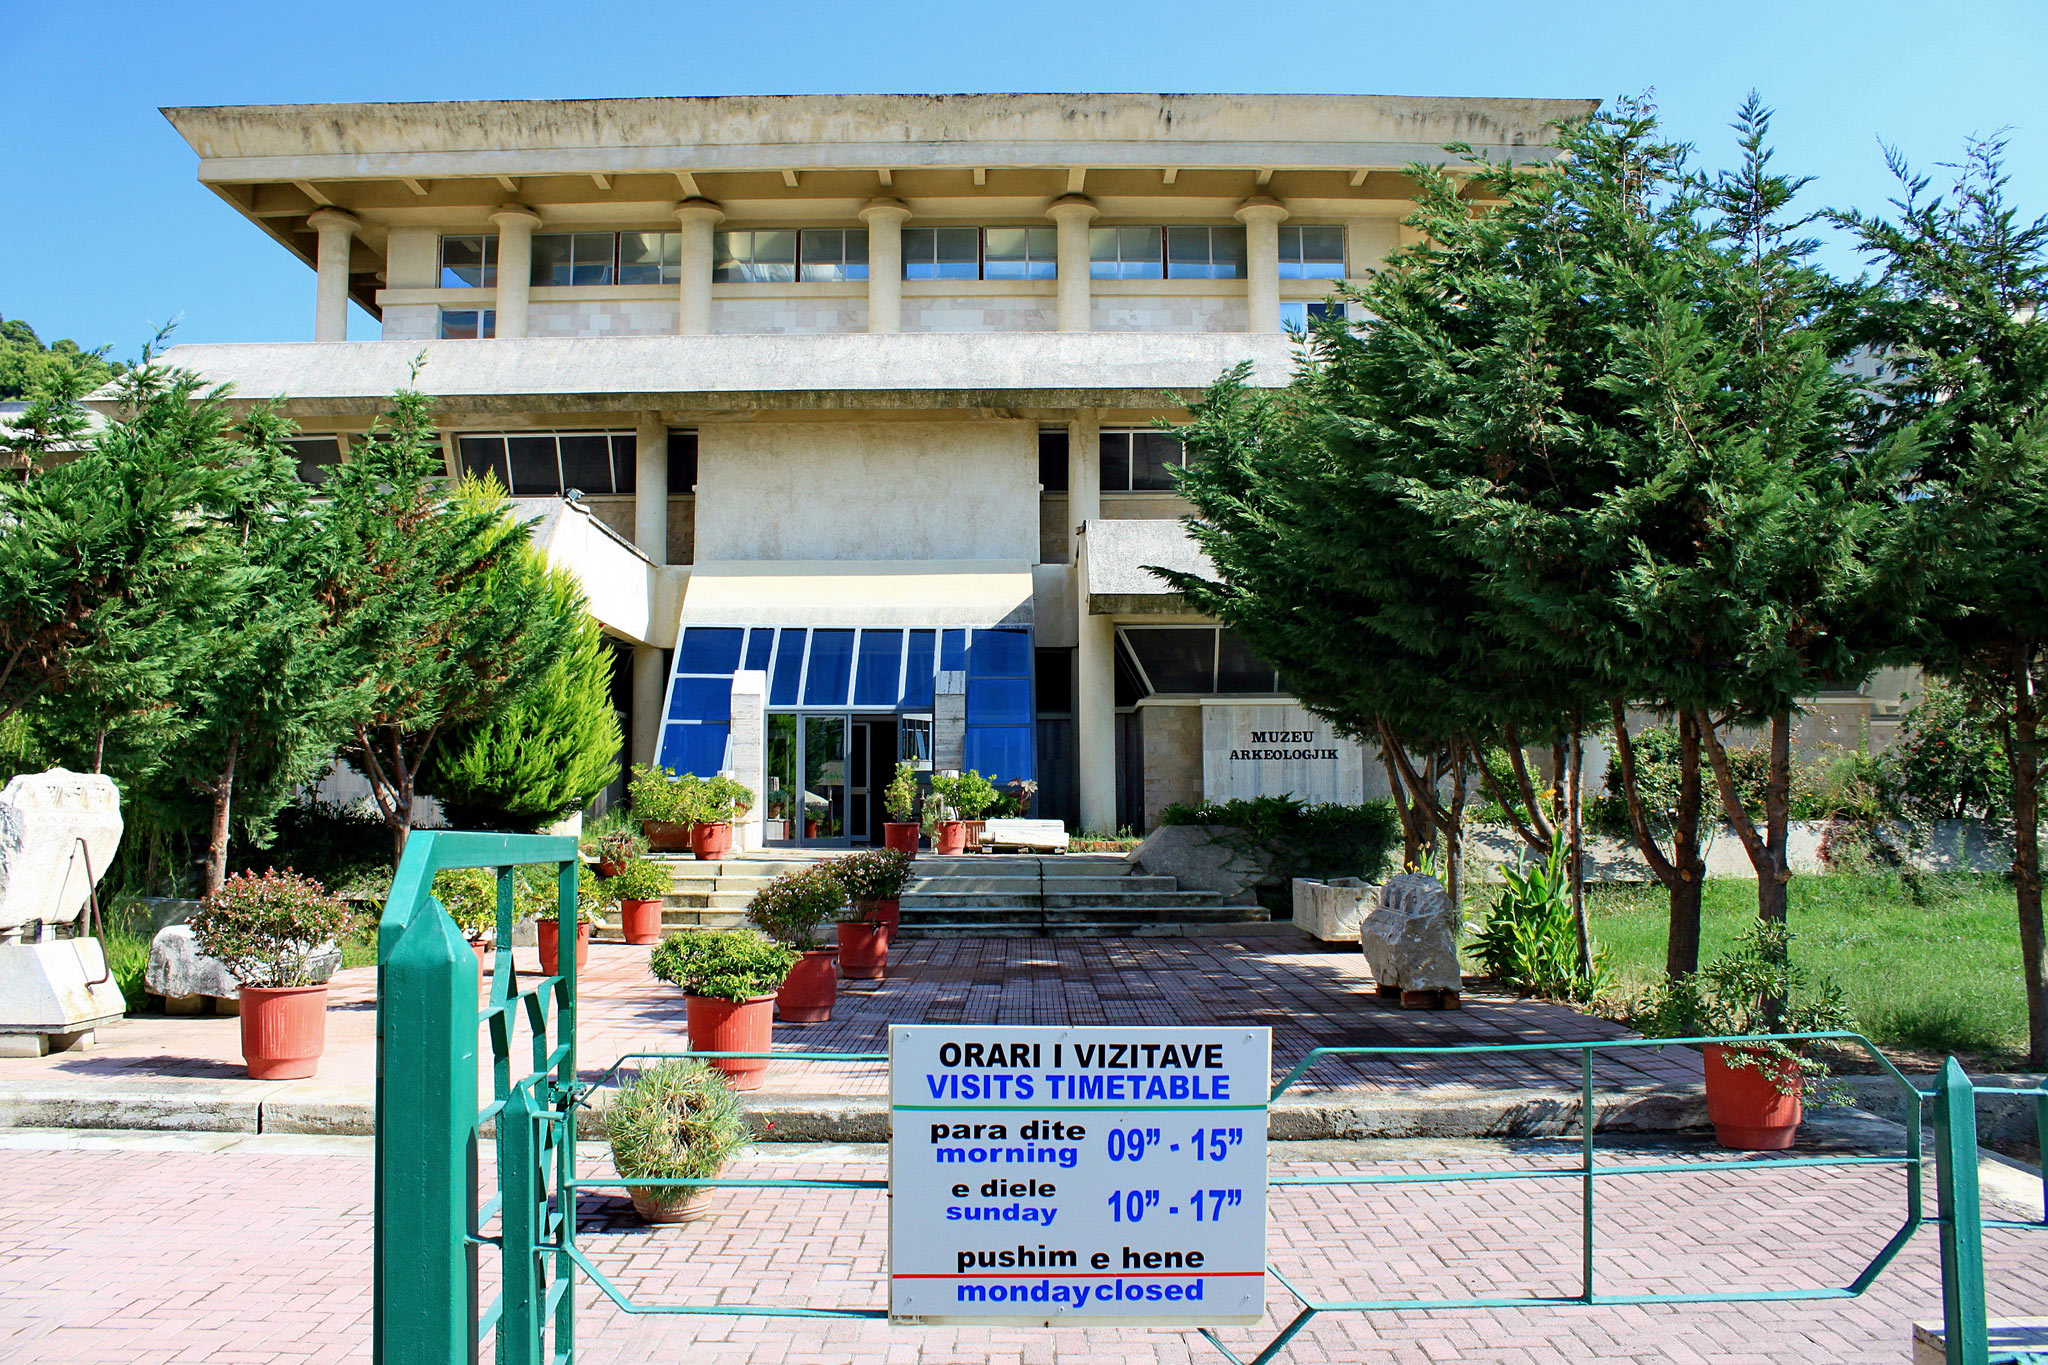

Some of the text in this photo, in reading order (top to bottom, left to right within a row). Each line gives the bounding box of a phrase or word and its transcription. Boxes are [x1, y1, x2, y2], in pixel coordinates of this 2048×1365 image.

[1250, 728, 1315, 744] MUZEU
[1228, 748, 1339, 763] ARKEOLOGJIK
[939, 1042, 1223, 1069] ORARI I VIZITAVE
[925, 1073, 1230, 1100] VISITS TIMETABLE
[930, 1119, 1086, 1144] para dite
[935, 1142, 1078, 1169] morning
[951, 1178, 1056, 1198] e diele
[945, 1202, 1058, 1227] sunday
[957, 1244, 1205, 1274] pushim e hene
